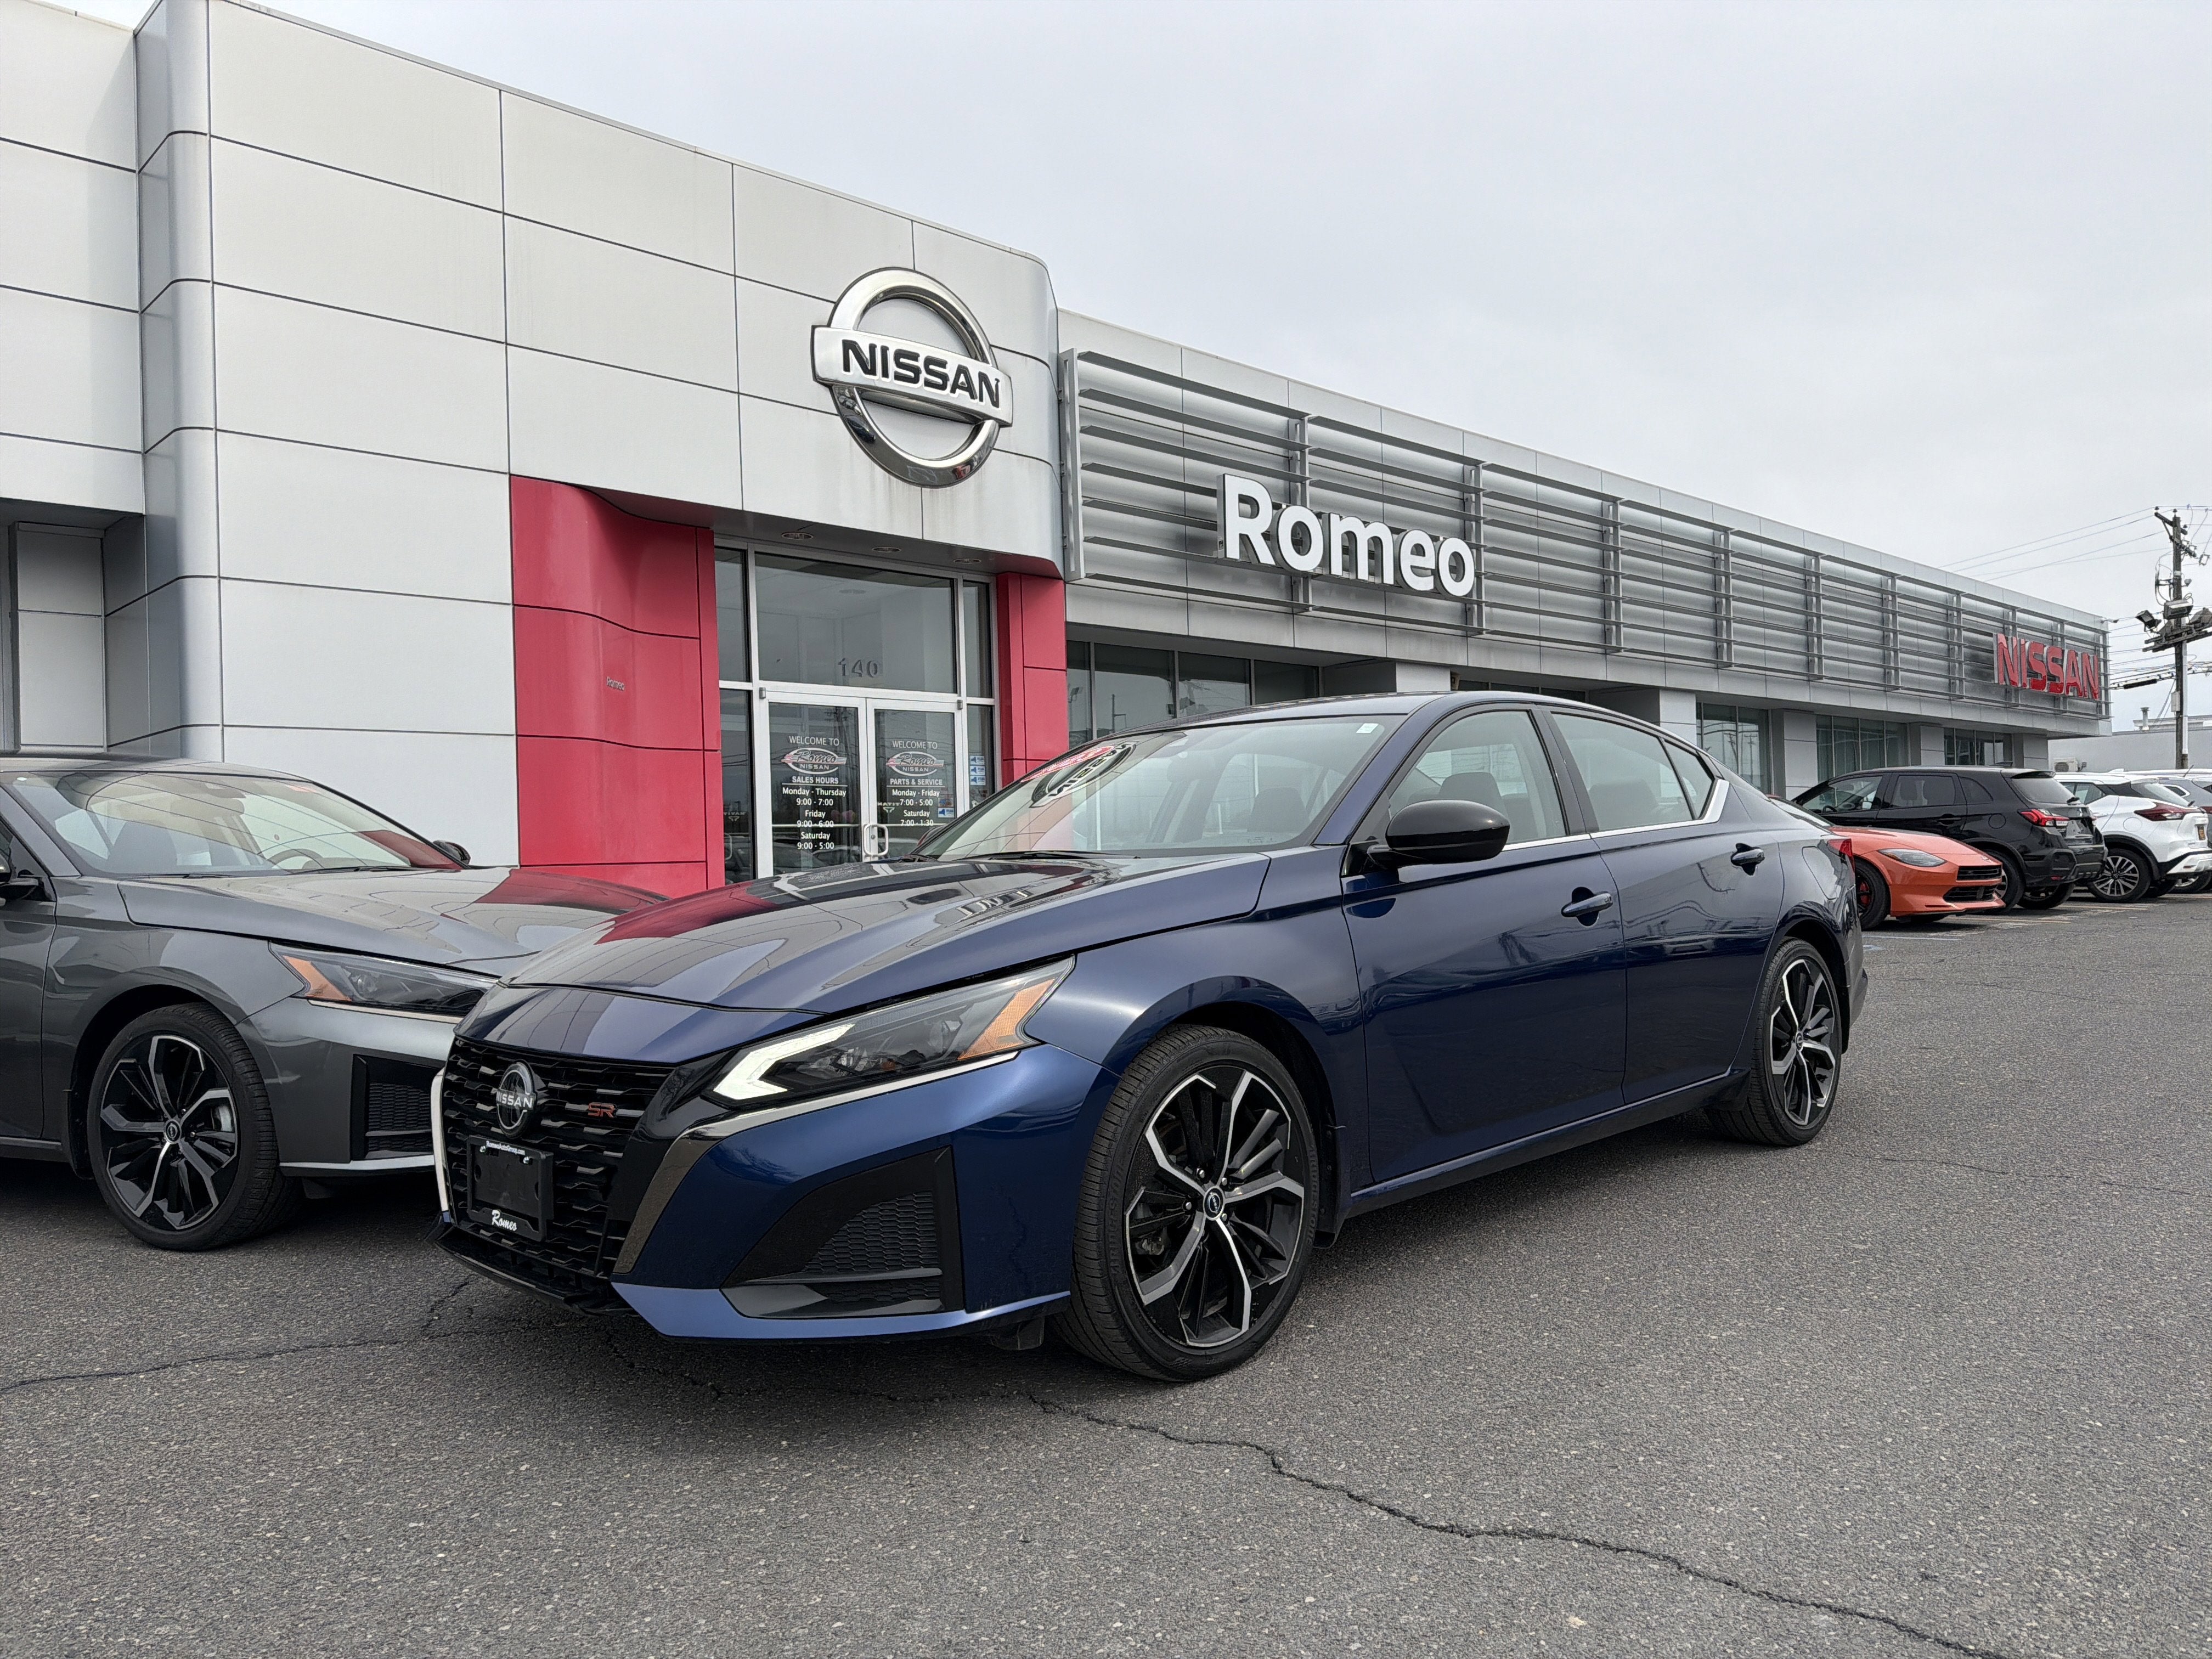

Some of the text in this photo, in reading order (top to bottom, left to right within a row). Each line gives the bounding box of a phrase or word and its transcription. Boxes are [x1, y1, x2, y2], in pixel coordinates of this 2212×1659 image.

[842, 338, 1000, 409] NISSAN
[1217, 473, 1475, 597] Romeo
[838, 658, 879, 678] 140
[1994, 633, 2099, 700] NISSAN
[789, 736, 839, 746] WELCOME TO
[893, 741, 926, 749] WELCOME
[794, 750, 837, 763] Romeo
[899, 754, 935, 765] Romeo
[782, 787, 810, 796] Monday
[815, 788, 847, 797] Thursday
[892, 789, 916, 797] Monday
[805, 810, 826, 819] Friday
[800, 832, 830, 840] Saturday
[496, 1091, 533, 1108] NISSAN
[588, 1102, 616, 1118] SR
[492, 1210, 517, 1232] Romeo
